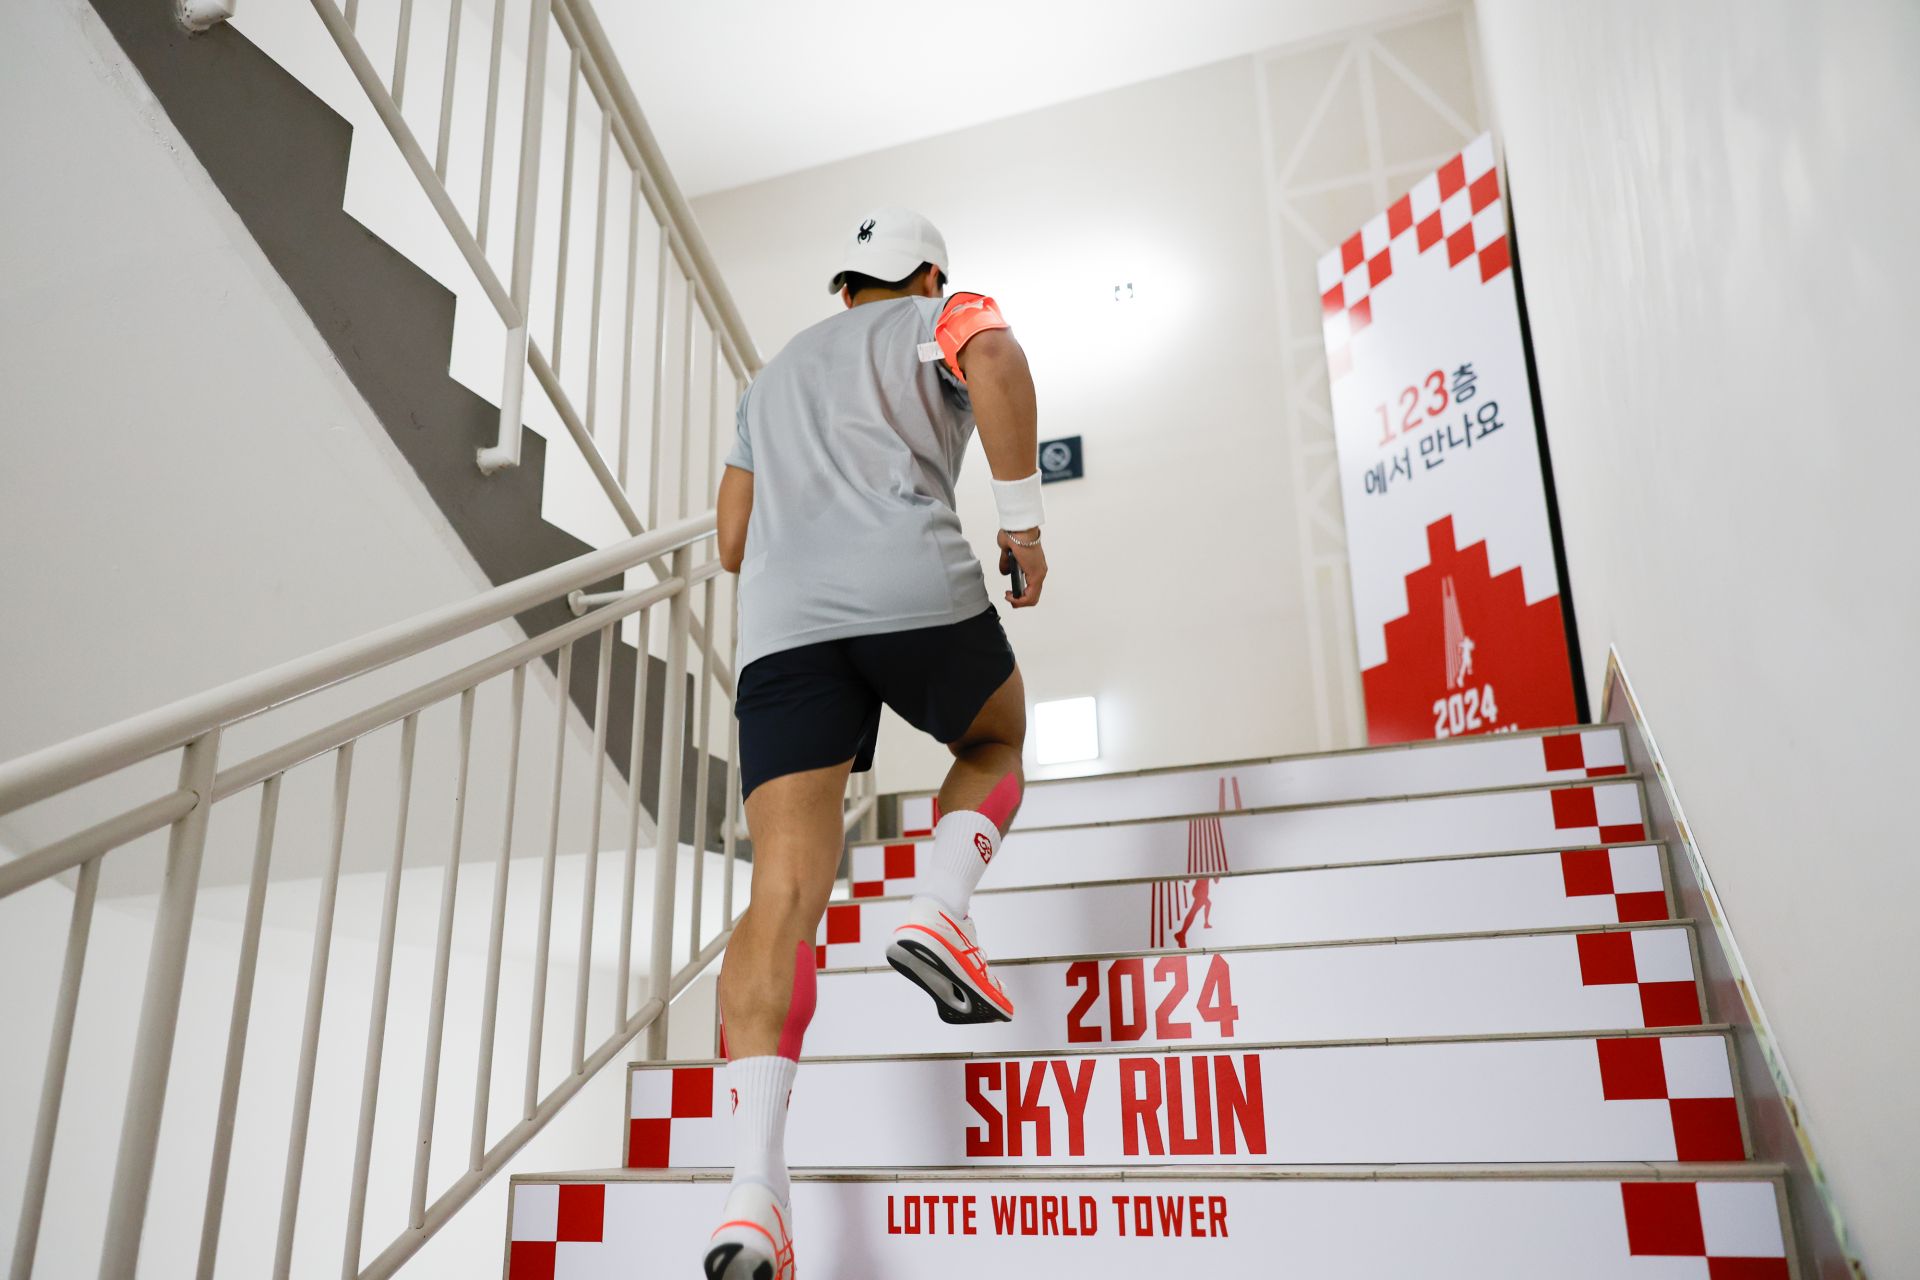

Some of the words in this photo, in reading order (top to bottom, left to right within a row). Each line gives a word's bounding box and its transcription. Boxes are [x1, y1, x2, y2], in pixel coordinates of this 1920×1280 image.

[1364, 446, 1412, 494] 에서
[1420, 400, 1504, 470] 만나요
[1376, 361, 1478, 447] 123층
[1433, 683, 1498, 739] 2024
[1065, 953, 1239, 1043] 2024
[965, 1059, 1097, 1157] SKY
[1119, 1054, 1268, 1156] RUN
[887, 1195, 977, 1235] LOTTE
[991, 1195, 1099, 1236] WORLD
[1112, 1195, 1229, 1238] TOWER
